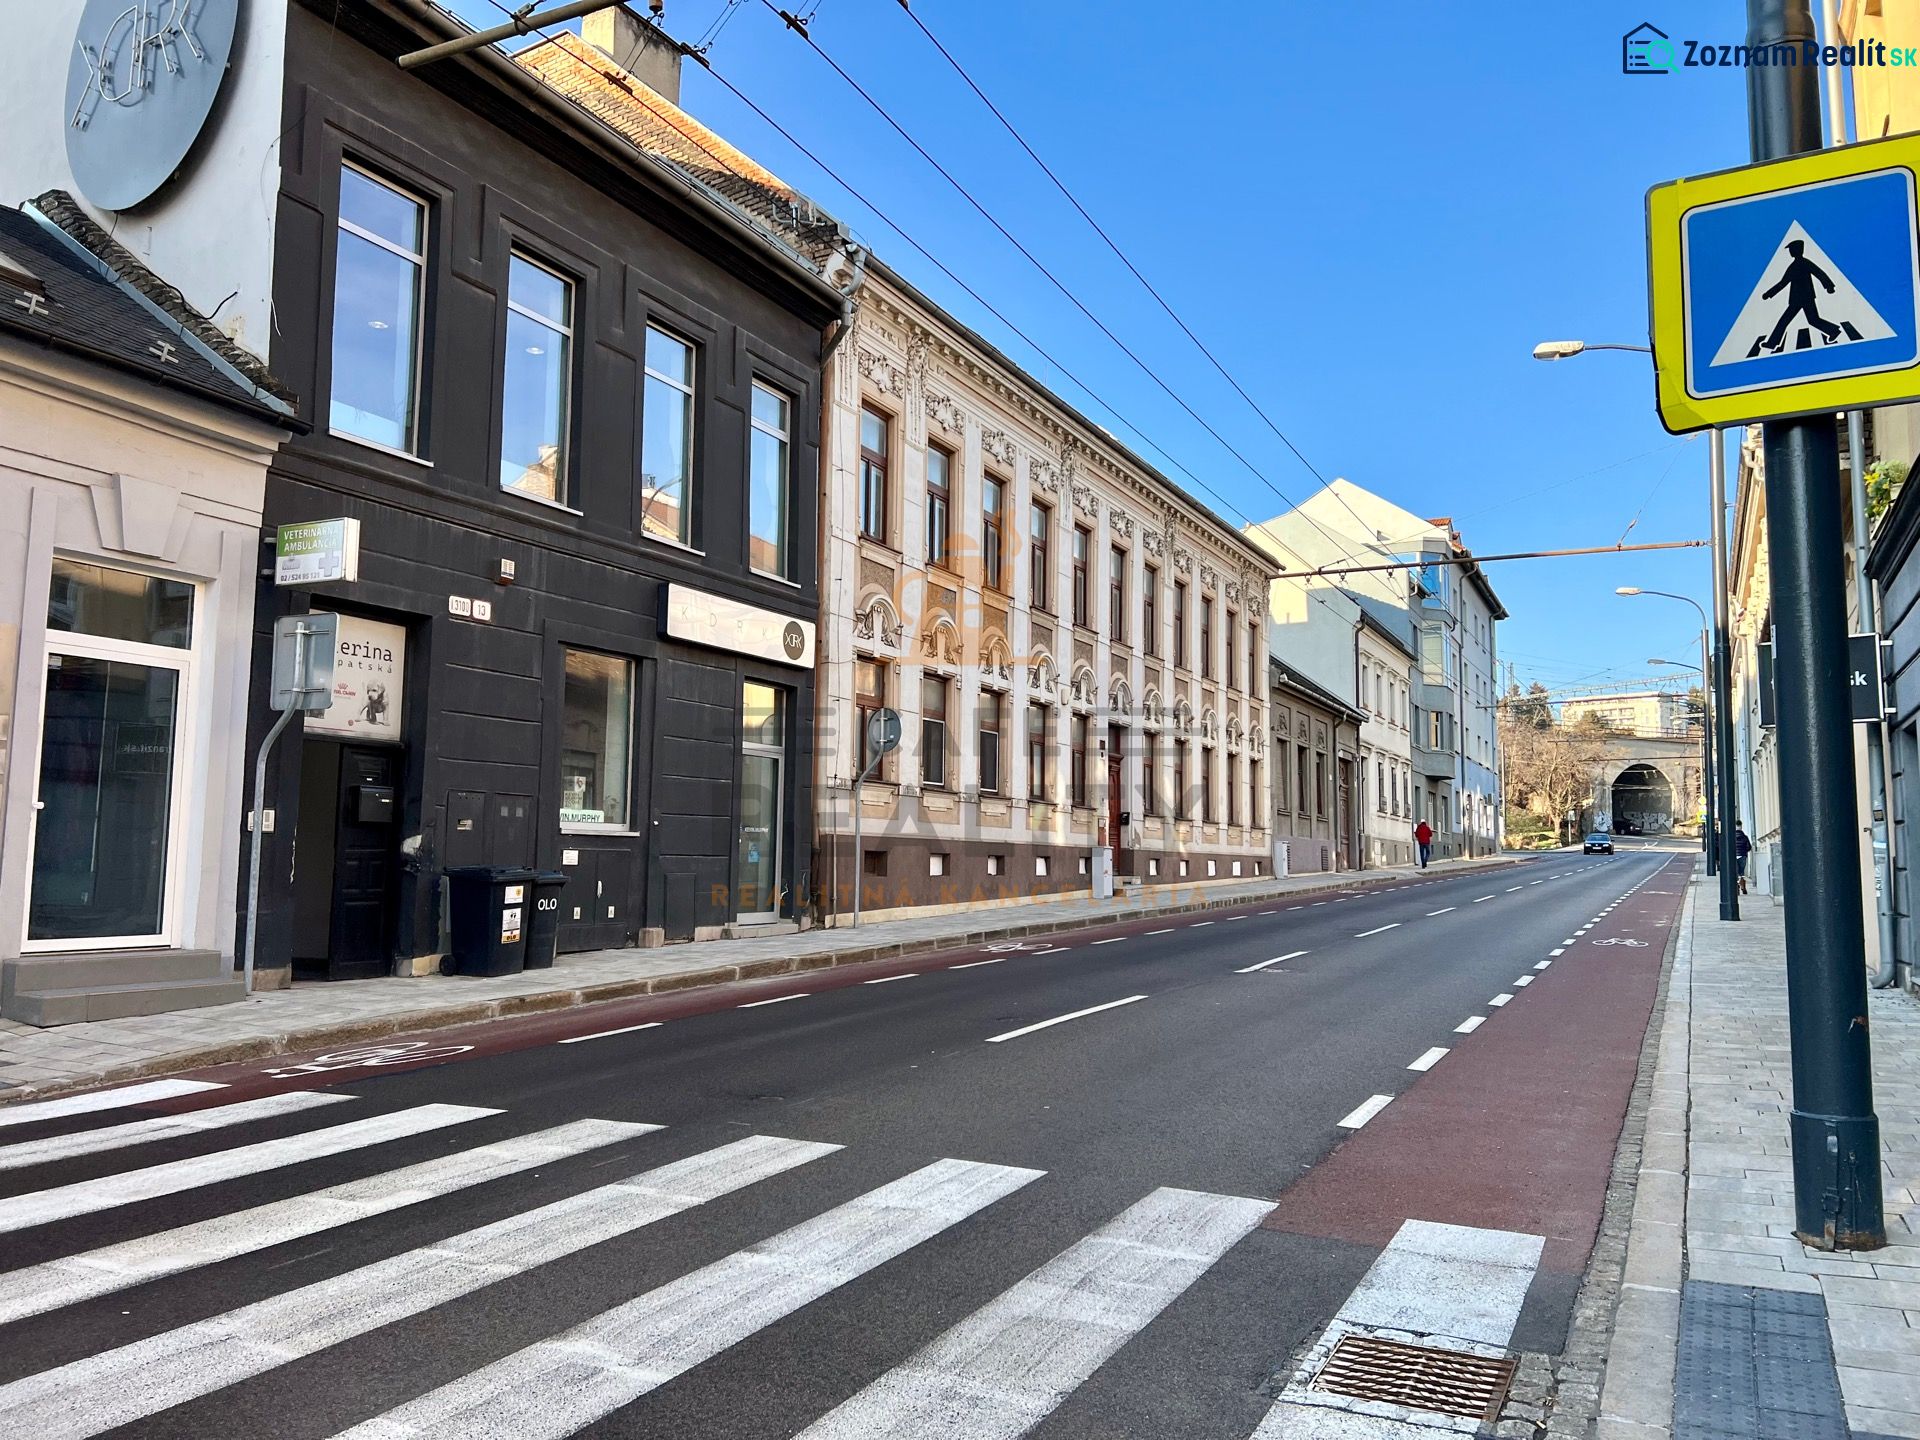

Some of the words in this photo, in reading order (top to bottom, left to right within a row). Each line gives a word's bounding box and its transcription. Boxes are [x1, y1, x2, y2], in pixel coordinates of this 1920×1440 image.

[478, 604, 487, 616] 13
[337, 641, 393, 662] erina
[537, 898, 558, 911] OLO
